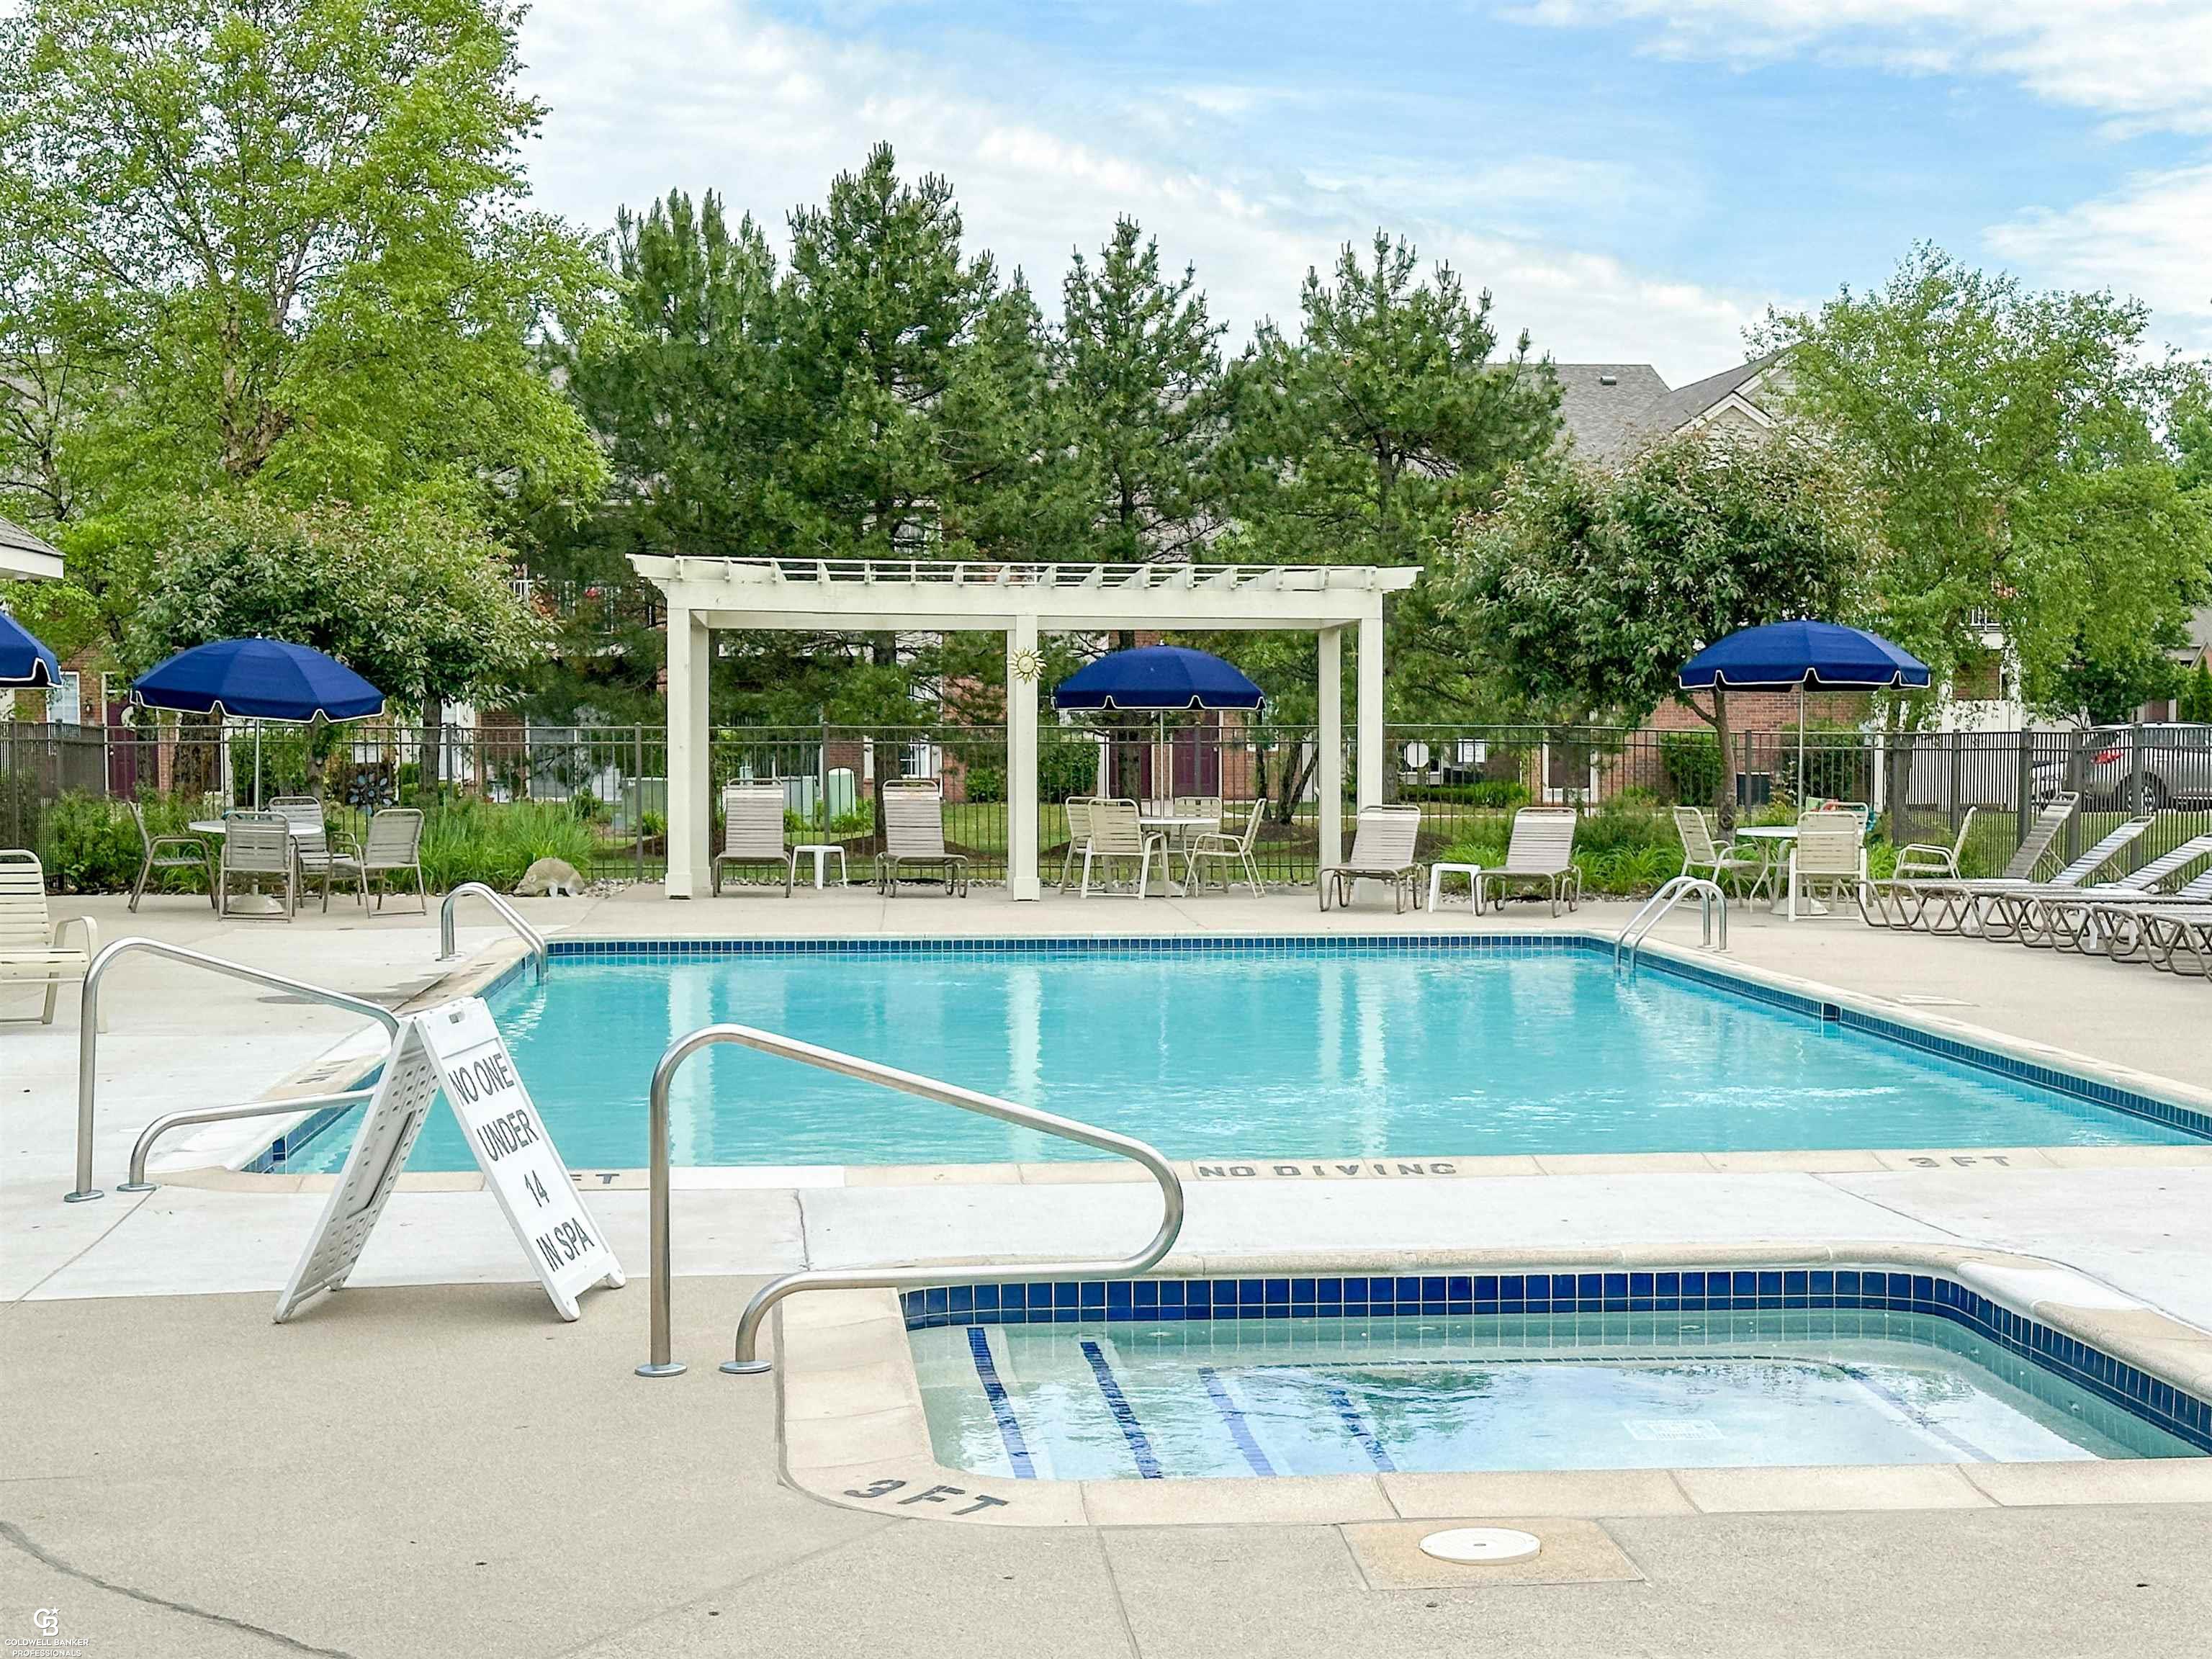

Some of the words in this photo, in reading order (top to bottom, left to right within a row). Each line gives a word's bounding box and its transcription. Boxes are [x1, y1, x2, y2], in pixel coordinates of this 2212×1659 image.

[448, 1066, 480, 1106] NO
[473, 1053, 515, 1096] ONE
[477, 1109, 539, 1161] UNDER
[524, 1170, 550, 1208] 14
[1199, 1166, 1256, 1177] NO
[1273, 1163, 1457, 1177] DIVING
[536, 1233, 565, 1272] IN
[554, 1218, 595, 1262] SPA
